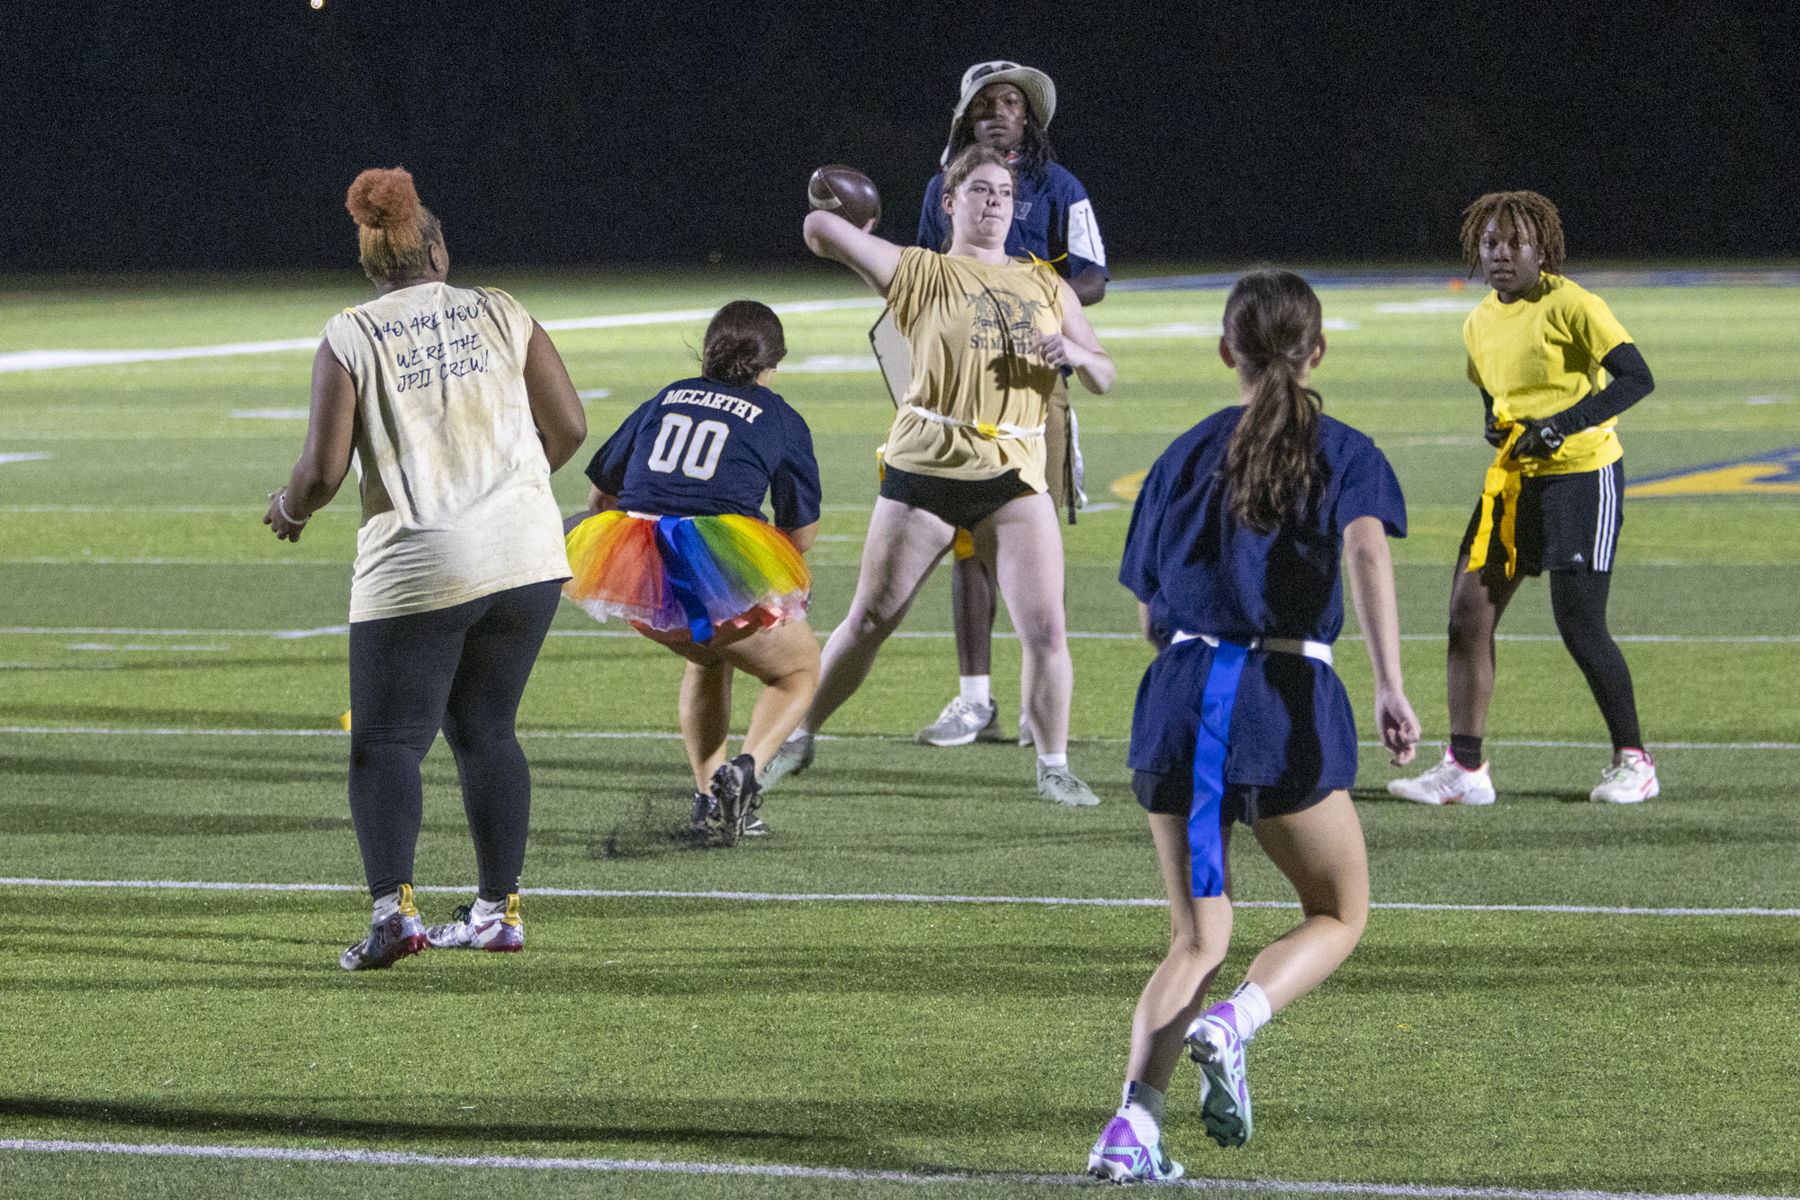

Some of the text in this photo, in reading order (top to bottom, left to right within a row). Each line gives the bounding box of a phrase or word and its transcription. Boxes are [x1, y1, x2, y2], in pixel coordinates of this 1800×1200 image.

[409, 312, 443, 336] ARE
[445, 297, 488, 330] YOU?
[450, 333, 482, 355] THE
[397, 349, 489, 392] JPII CREW!
[661, 388, 763, 424] MCCARTHY
[647, 412, 730, 481] 00
